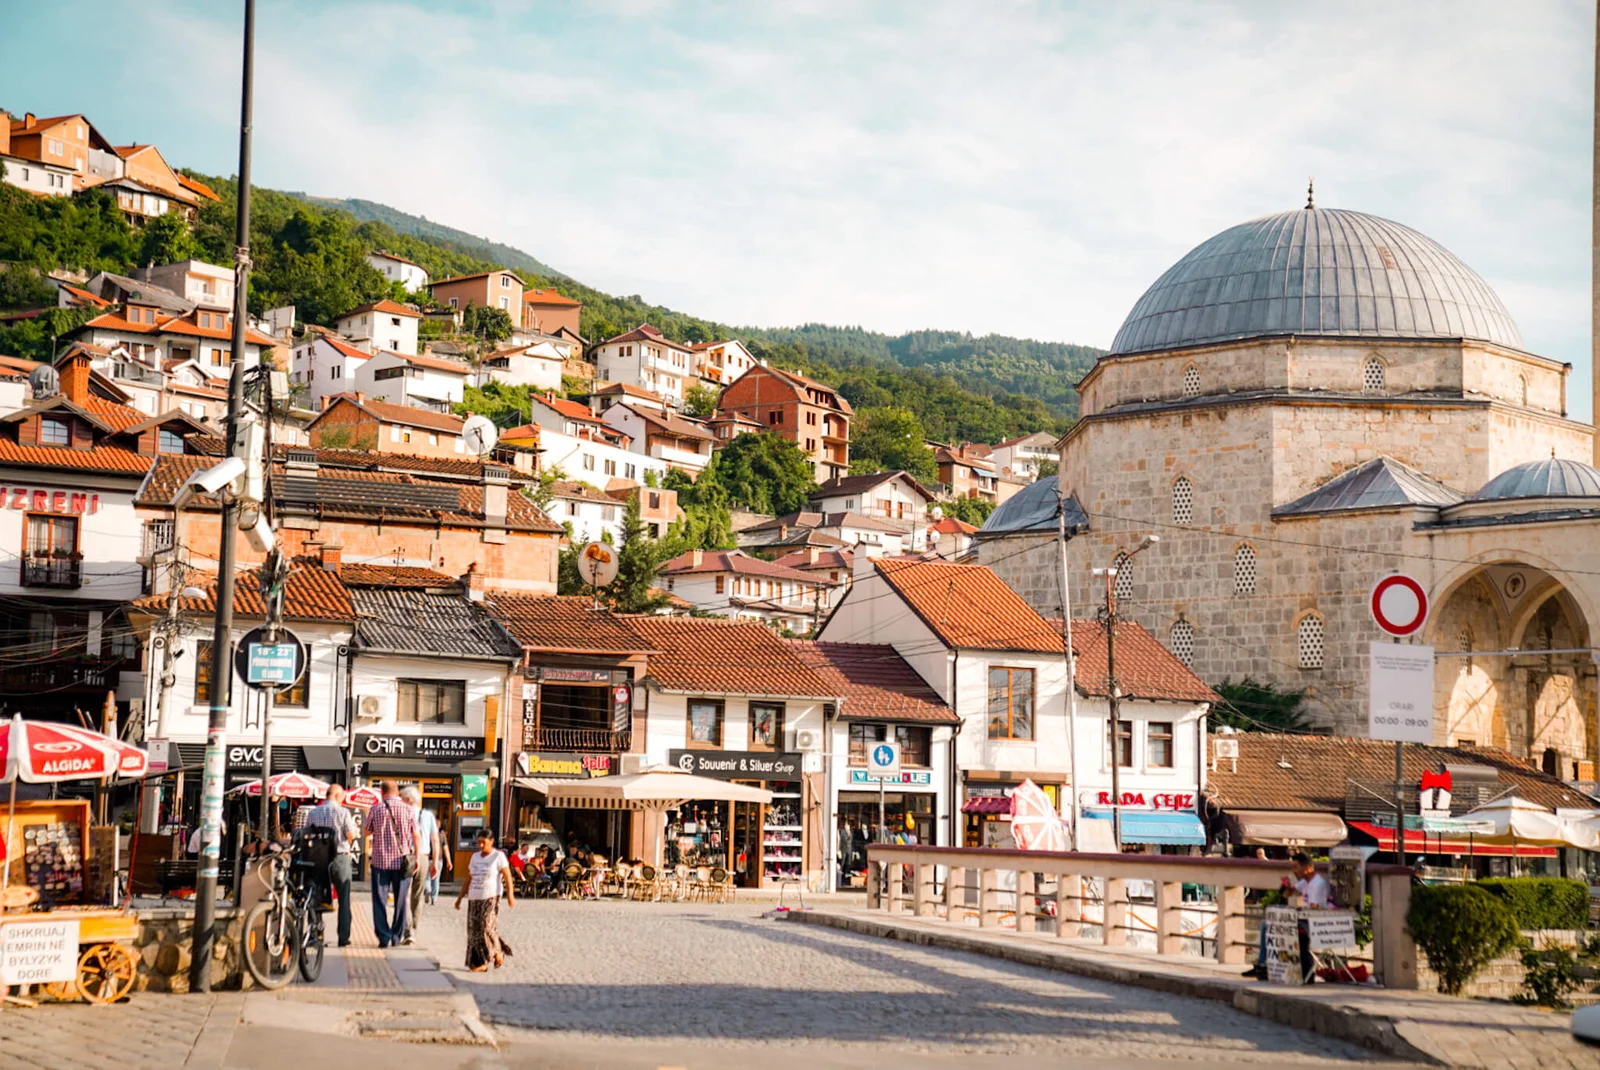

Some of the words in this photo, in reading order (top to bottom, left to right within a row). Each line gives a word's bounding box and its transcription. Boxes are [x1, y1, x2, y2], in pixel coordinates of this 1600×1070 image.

[416, 738, 476, 750] FILIGRAN
[529, 755, 582, 775] Banana
[582, 754, 610, 771] Split
[740, 759, 748, 771] &
[774, 761, 794, 776] Shop
[8, 926, 66, 939] SHKRUAJ
[7, 941, 46, 953] EMRIN
[9, 954, 61, 967] BYLYZYK
